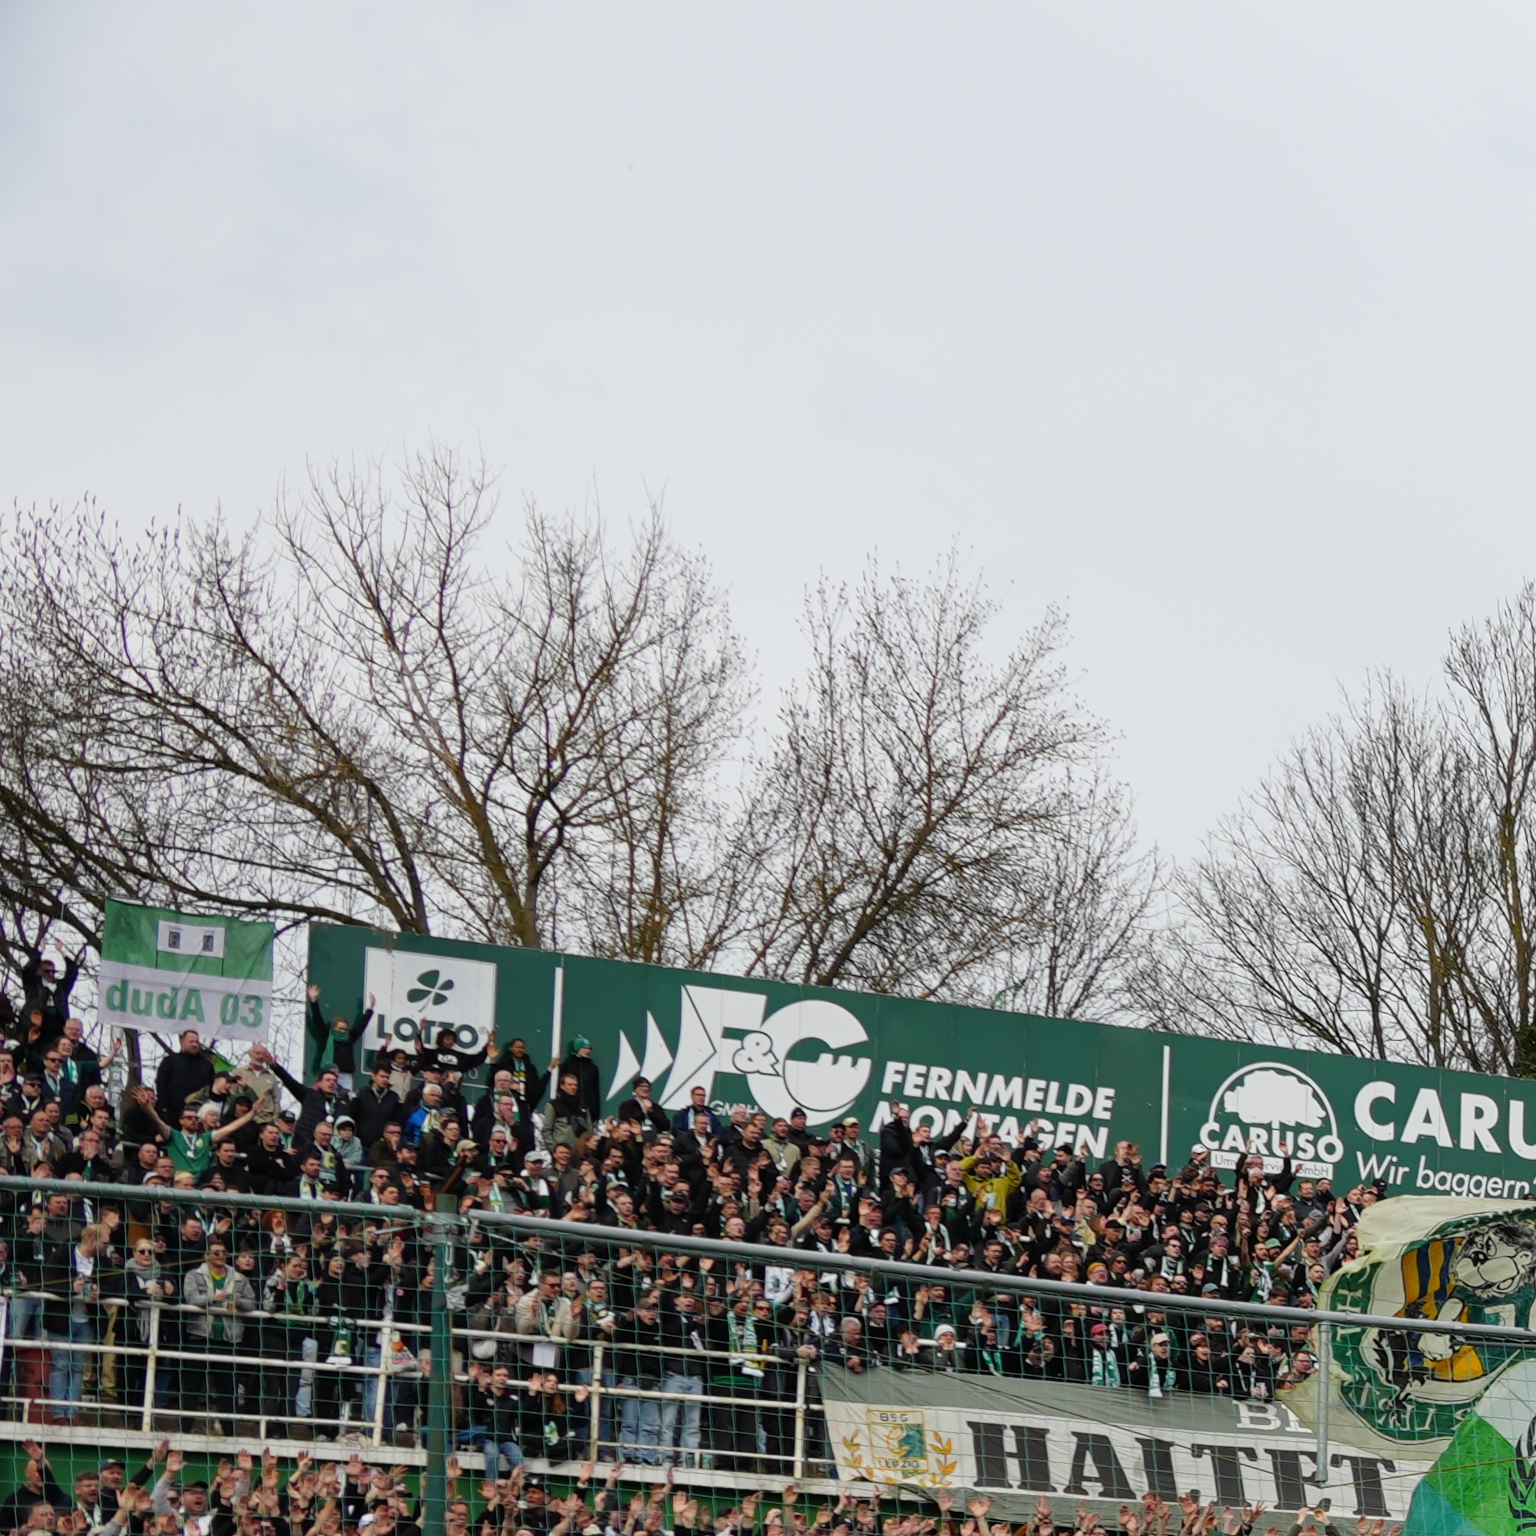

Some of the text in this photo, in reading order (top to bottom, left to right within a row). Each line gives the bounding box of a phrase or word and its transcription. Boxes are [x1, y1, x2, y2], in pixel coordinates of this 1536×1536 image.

[106, 979, 264, 1028] dudA 03
[881, 1060, 1115, 1120] FERNMELDE
[1200, 1121, 1343, 1163] CARUSO
[1356, 1150, 1410, 1186] Wir
[966, 1420, 1396, 1519] HALTET
